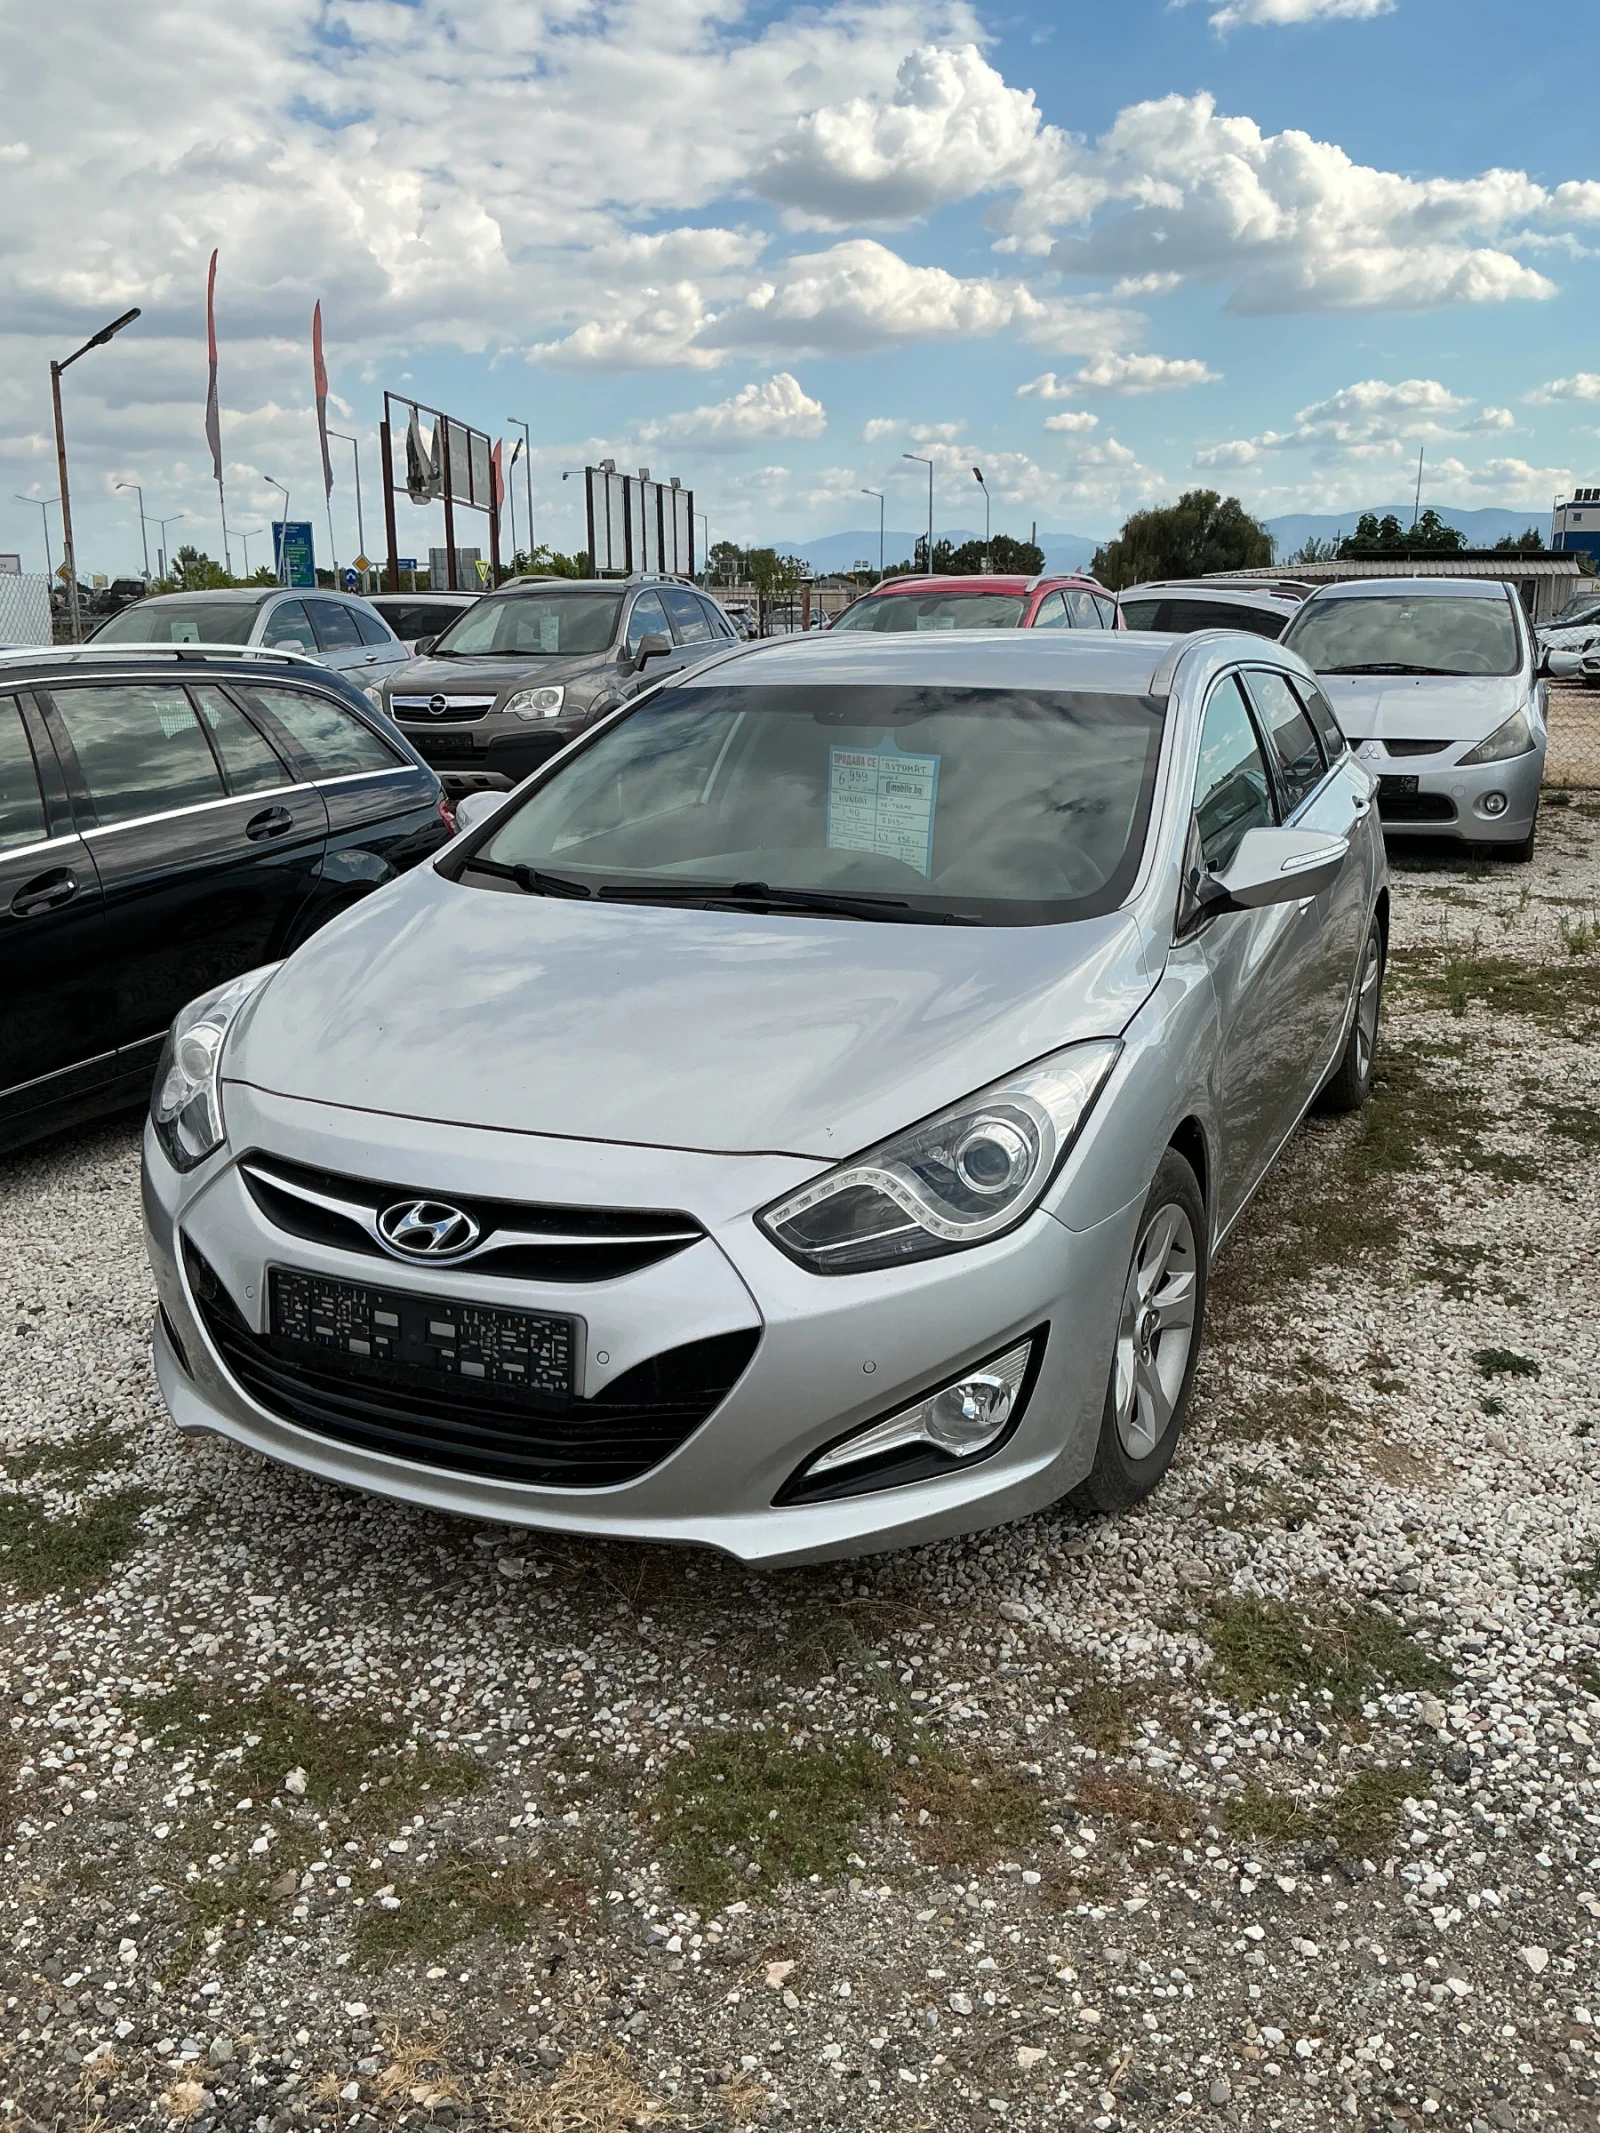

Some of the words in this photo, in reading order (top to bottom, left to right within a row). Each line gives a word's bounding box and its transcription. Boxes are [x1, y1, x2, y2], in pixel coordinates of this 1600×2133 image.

[833, 753, 866, 767] ПРОДАВА
[867, 756, 877, 768] СЕ
[838, 771, 845, 786] 6
[849, 769, 869, 783] 999
[891, 784, 922, 796] mobile.bg
